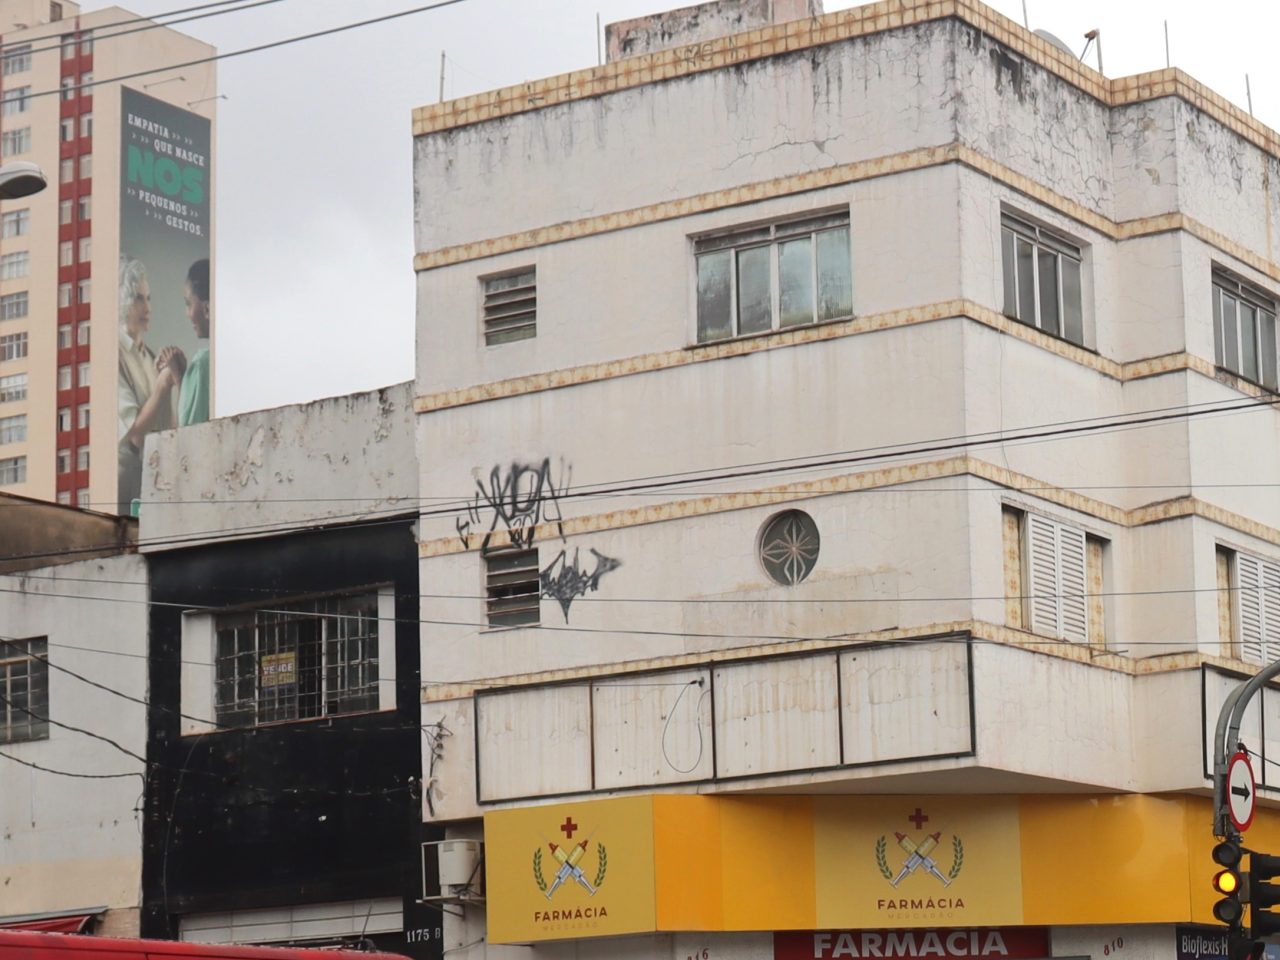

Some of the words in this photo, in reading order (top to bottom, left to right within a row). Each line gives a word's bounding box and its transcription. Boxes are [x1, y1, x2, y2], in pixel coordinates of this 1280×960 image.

[128, 113, 169, 139] EMPATIA
[154, 139, 172, 154] QUE
[175, 146, 205, 166] NASCE
[127, 144, 204, 204] NOS
[138, 190, 188, 216] PEQUENOS
[534, 906, 608, 922] FARMÁCIA
[877, 896, 964, 910] FARMÁCIA
[407, 928, 430, 943] 1175
